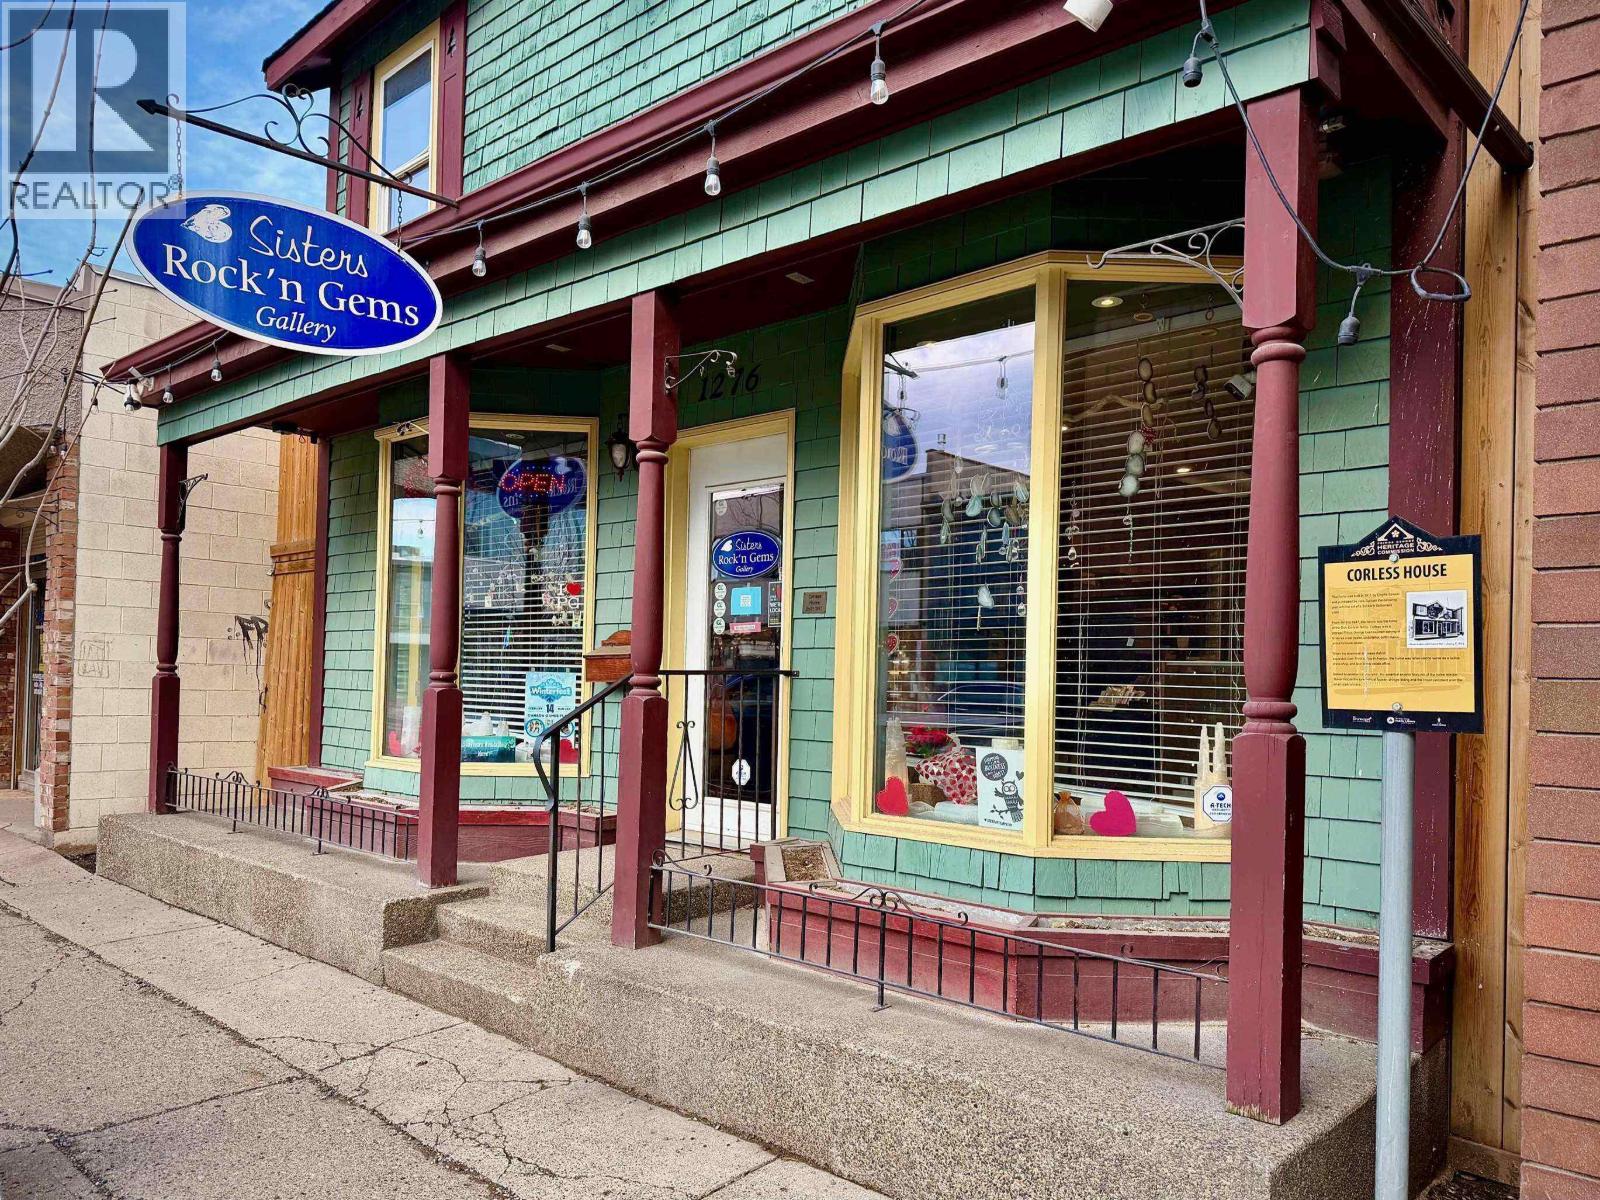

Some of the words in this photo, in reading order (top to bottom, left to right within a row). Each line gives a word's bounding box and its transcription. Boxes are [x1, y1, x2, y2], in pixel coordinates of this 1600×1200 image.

[248, 215, 369, 279] Sisters
[318, 280, 421, 328] Gems
[255, 306, 338, 343] Gallery
[698, 364, 761, 402] 1276
[501, 473, 565, 494] OPEN
[735, 537, 763, 551] Sisters
[749, 552, 774, 563] Gems
[1347, 566, 1400, 582] CORLESS
[1403, 563, 1447, 580] HOUSE
[545, 704, 555, 713] 14
